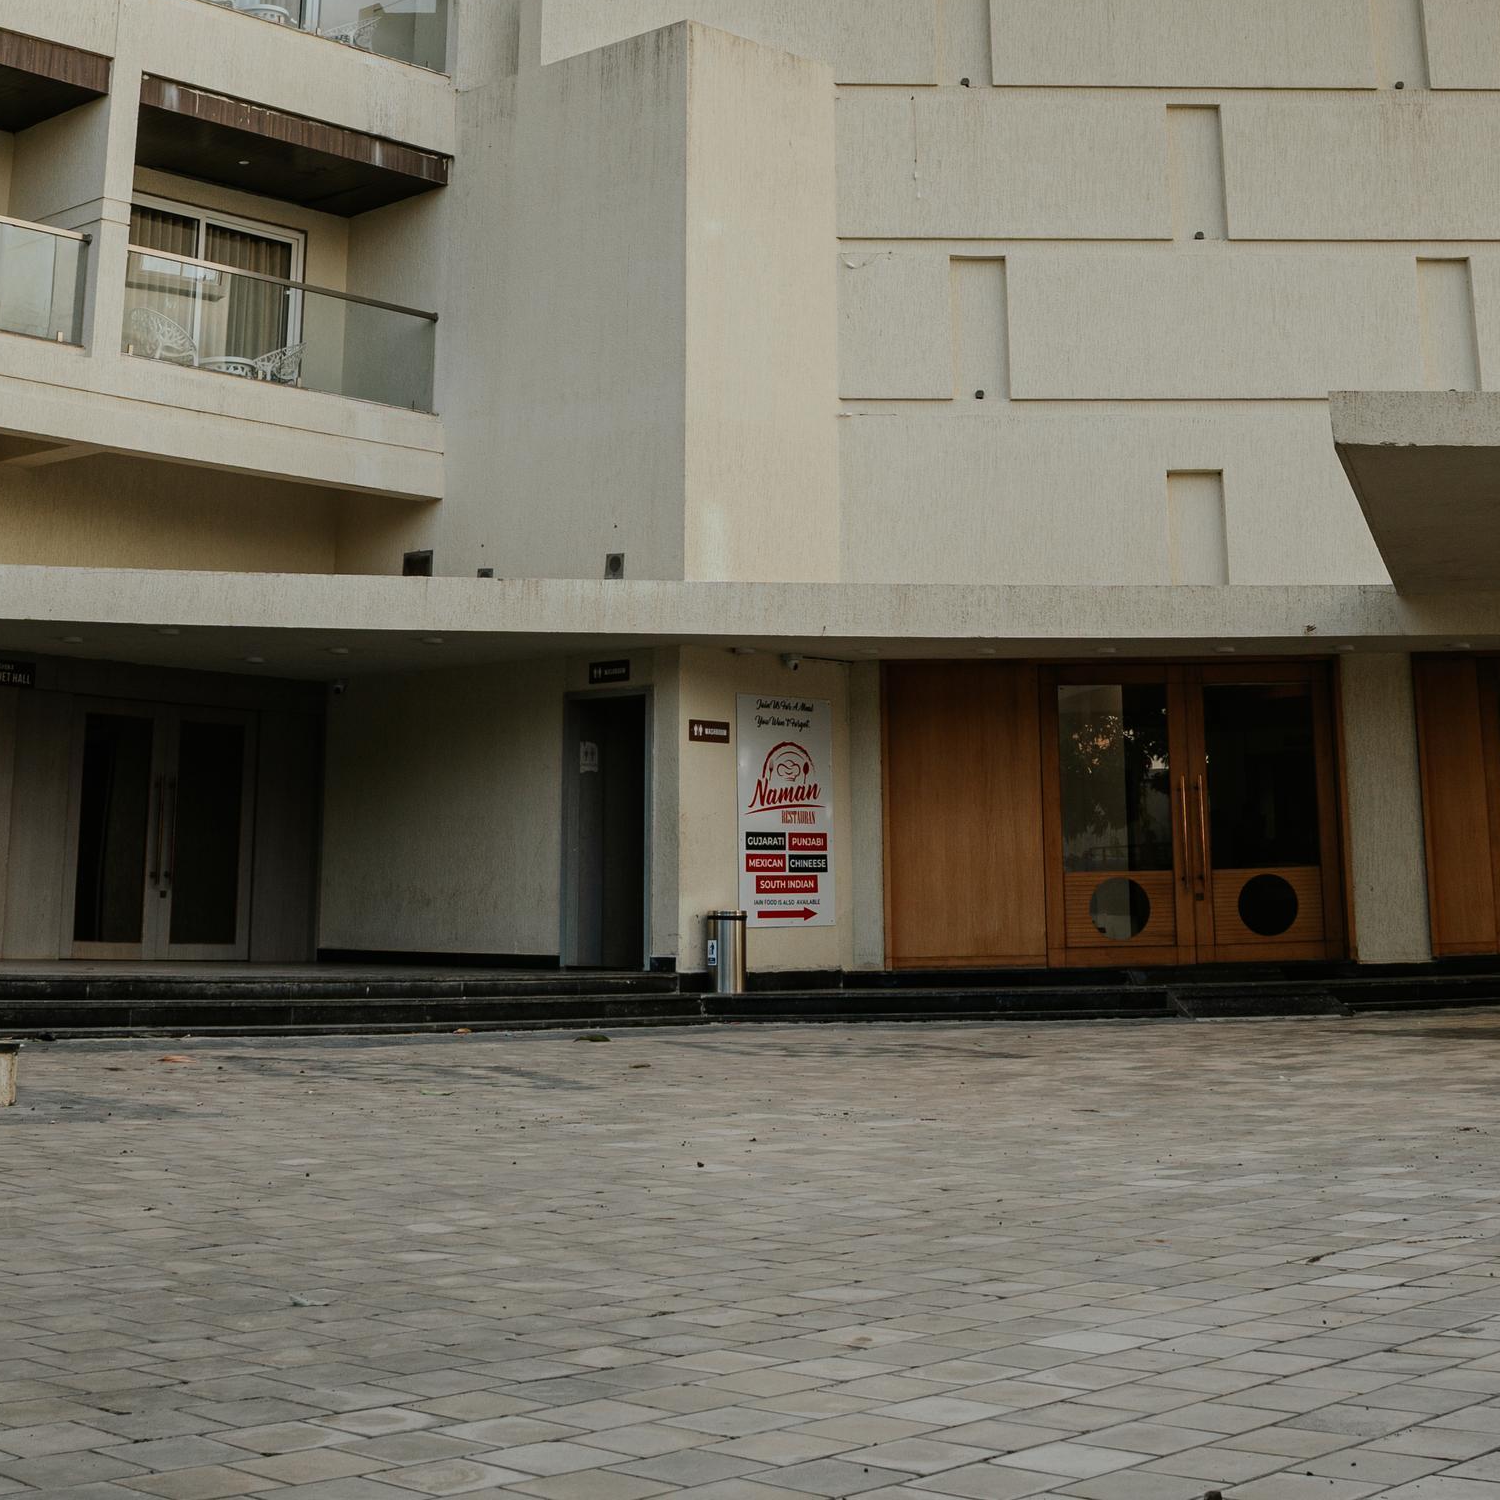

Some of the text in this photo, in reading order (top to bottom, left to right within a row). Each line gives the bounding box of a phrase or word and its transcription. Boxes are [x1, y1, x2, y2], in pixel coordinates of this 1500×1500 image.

[12, 673, 30, 684] HALL
[748, 778, 821, 808] Naman
[747, 836, 824, 846] GUJARATI PUNJABI
[748, 858, 826, 868] MEXICAN CHINEESE
[760, 880, 814, 888] SOUTH INDIAN
